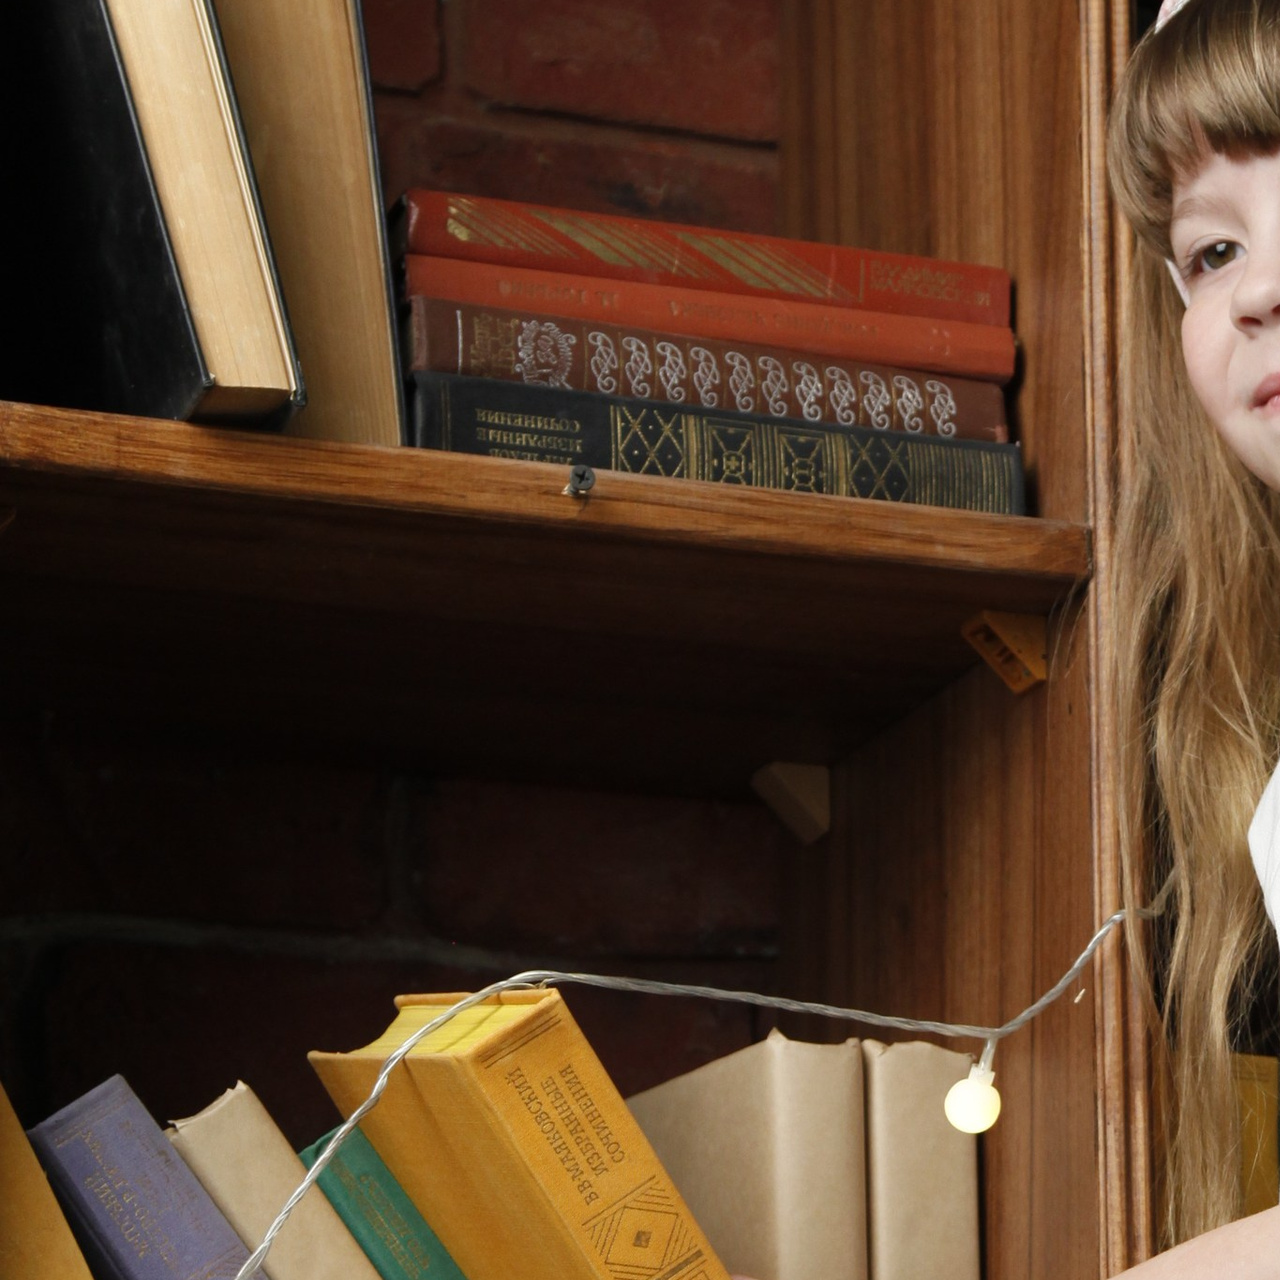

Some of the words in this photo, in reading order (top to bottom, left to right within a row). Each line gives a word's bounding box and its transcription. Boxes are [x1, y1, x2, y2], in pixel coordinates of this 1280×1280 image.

[475, 408, 580, 434] СОЧИНЕНИЯ
[476, 427, 583, 453] ИЗБРАННЫЕ
[540, 1075, 609, 1178] ИЗБРАННЫЕ
[558, 1063, 626, 1163] СОЧИНЕНИЯ
